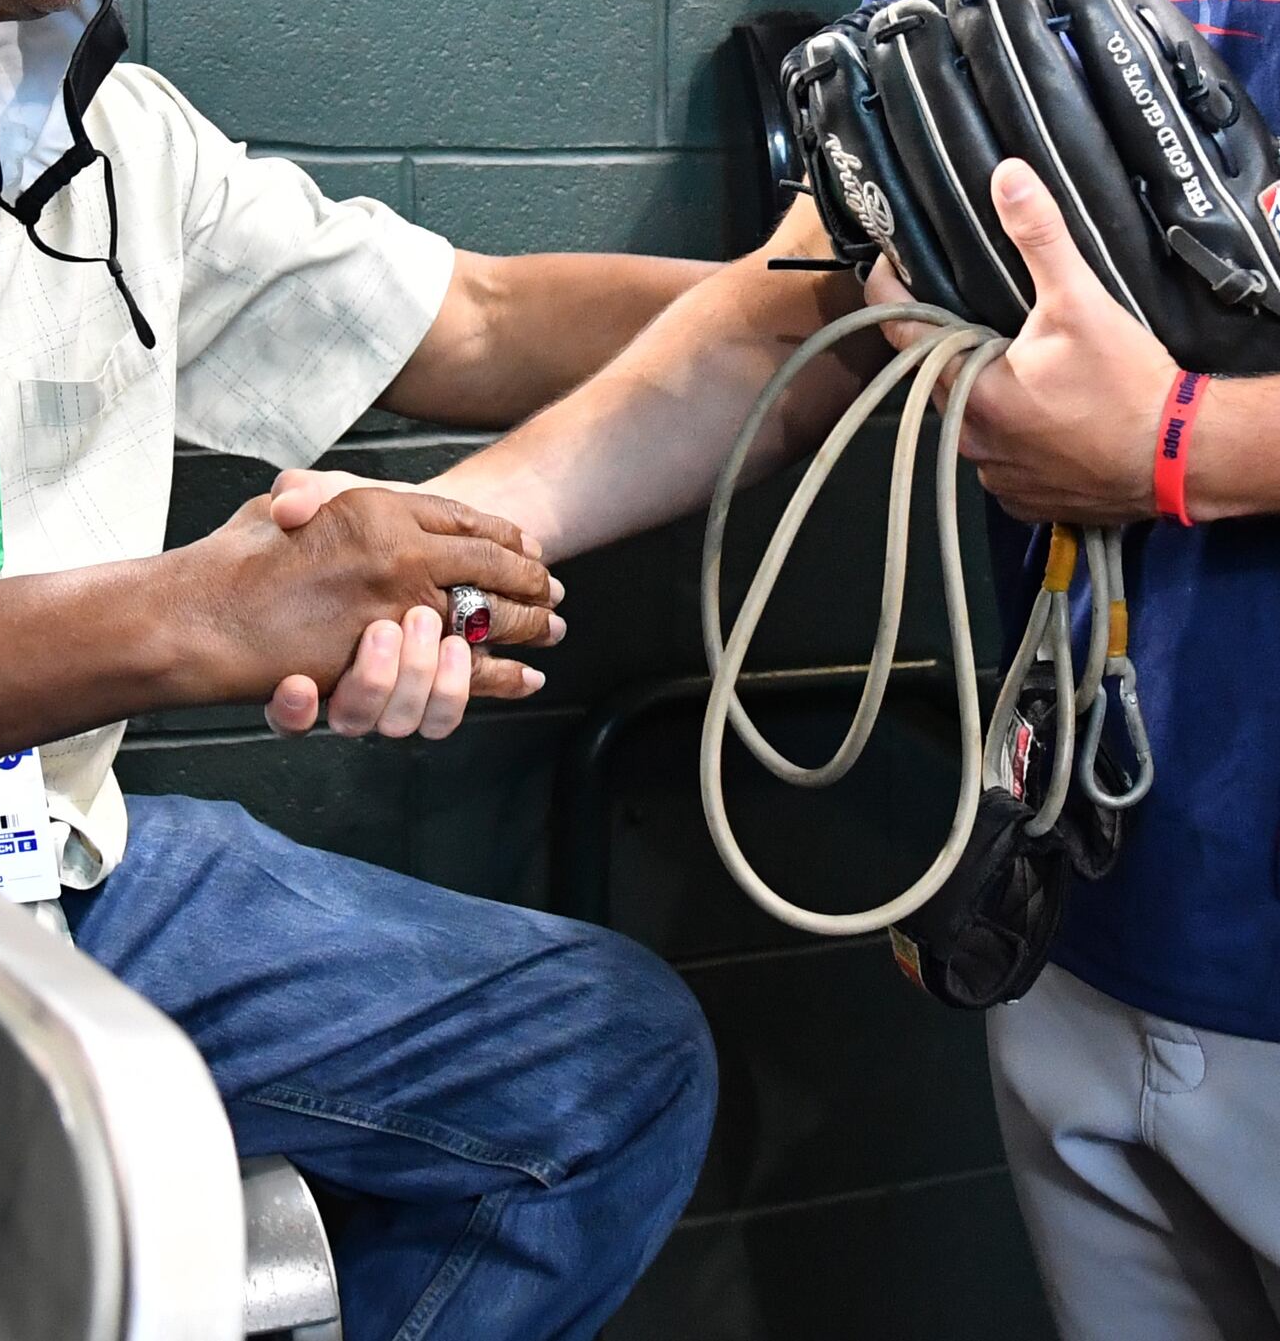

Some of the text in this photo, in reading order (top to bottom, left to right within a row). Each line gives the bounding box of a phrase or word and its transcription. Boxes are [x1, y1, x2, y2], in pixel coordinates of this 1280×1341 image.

[1107, 31, 1213, 217] THE GOLD GLOVE CO.
